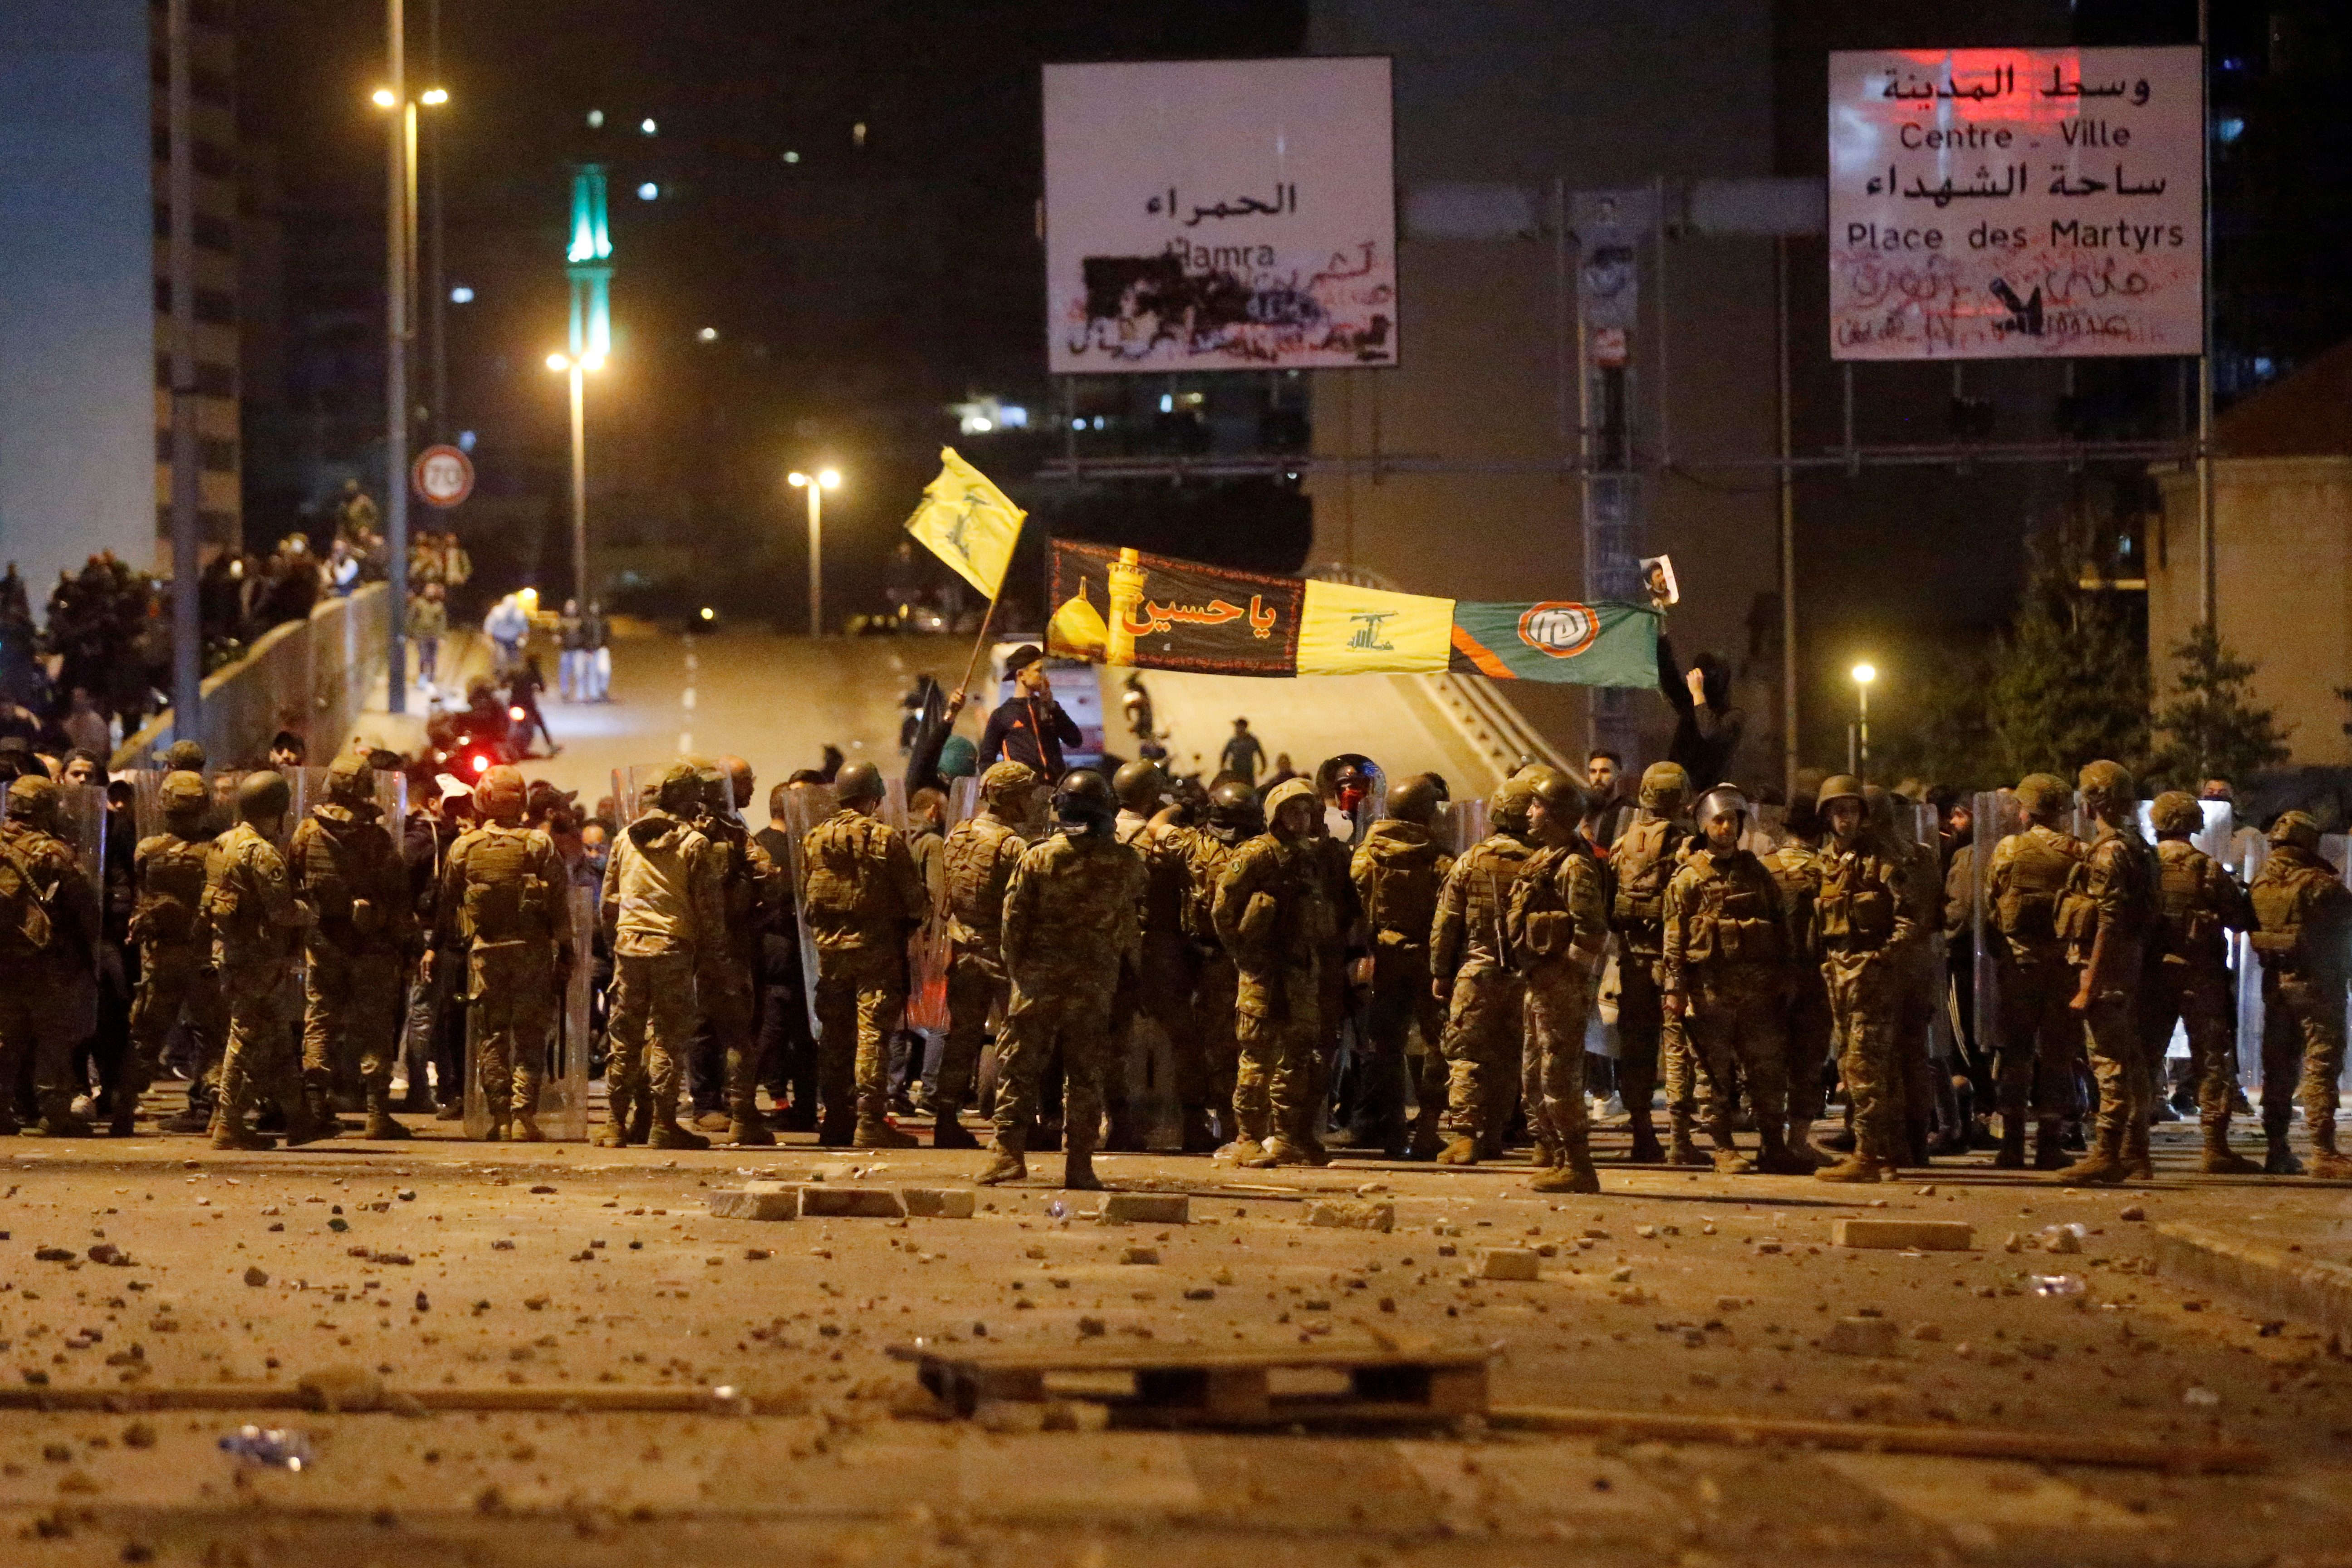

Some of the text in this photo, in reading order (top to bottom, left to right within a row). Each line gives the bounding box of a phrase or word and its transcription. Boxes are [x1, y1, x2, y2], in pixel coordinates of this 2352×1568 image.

[1882, 64, 2151, 110] وسط المدينة
[1899, 122, 2014, 150] Centre
[2060, 119, 2132, 147] Ville
[1147, 182, 1295, 226] الحمراء
[1867, 162, 2166, 208] ساحة الشهداء
[1847, 219, 2185, 254] Place des Martyrs
[1122, 592, 1245, 636] حسين
[1249, 594, 1277, 639] يا
